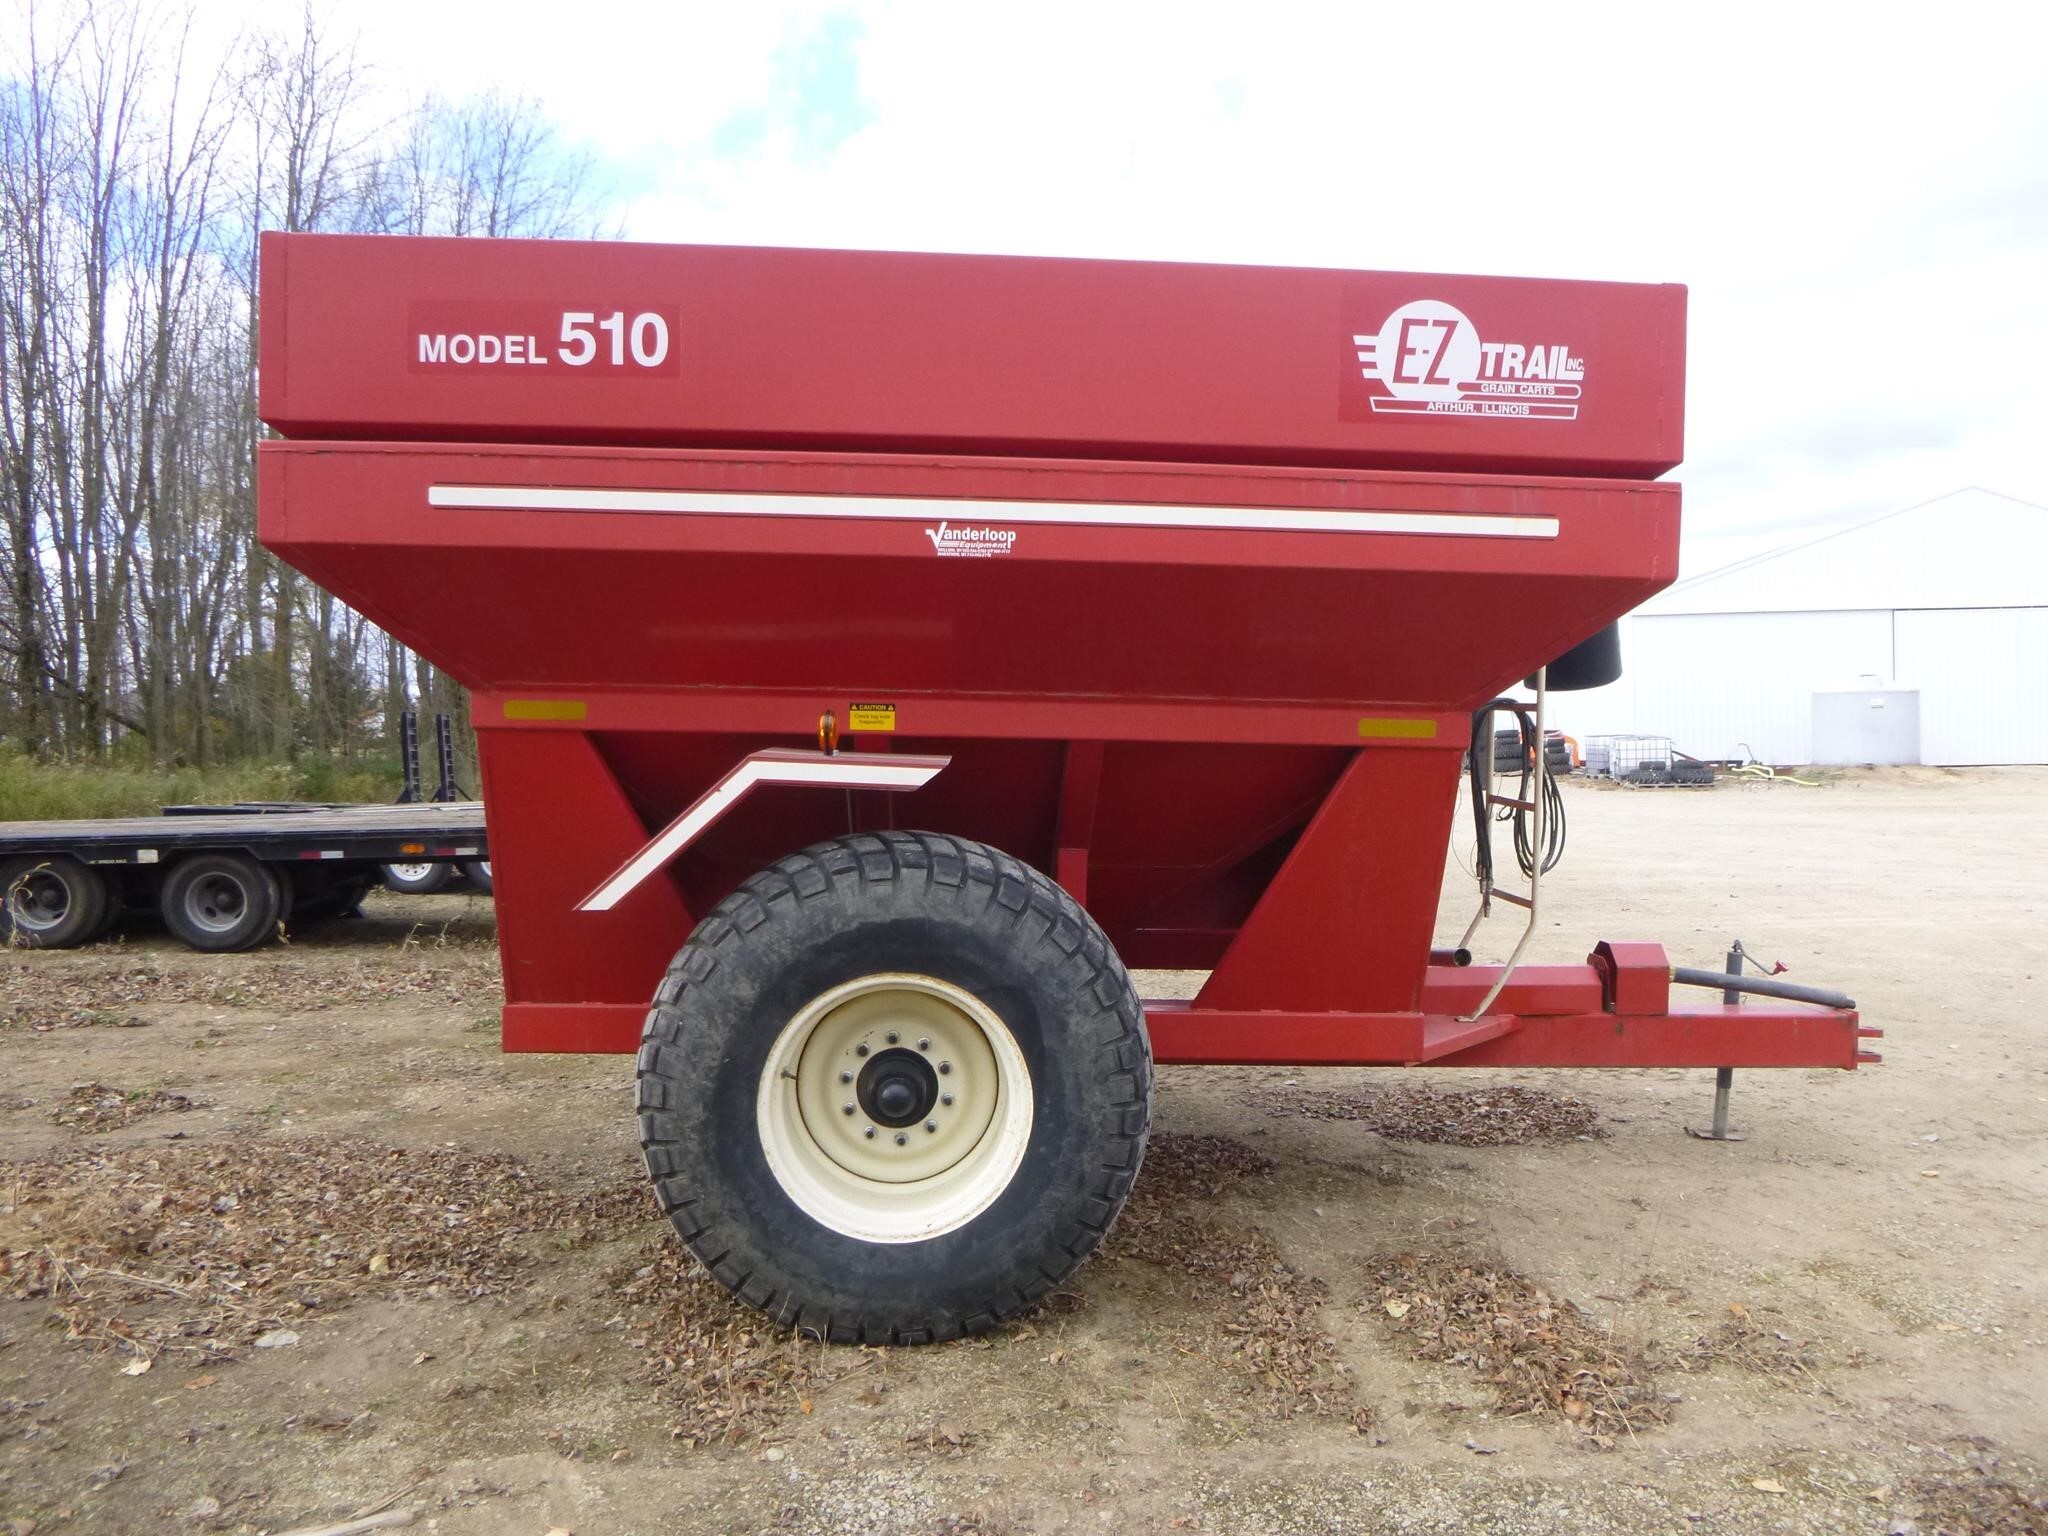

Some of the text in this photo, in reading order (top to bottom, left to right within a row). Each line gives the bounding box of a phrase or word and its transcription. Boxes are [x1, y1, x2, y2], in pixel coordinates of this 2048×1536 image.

[419, 311, 669, 367] MODEL 510
[1481, 342, 1585, 381] TRAIL
[1481, 383, 1556, 396] GRAIN CARTS
[1481, 403, 1530, 415] ILLINOIS
[925, 521, 1016, 549] Vanderloop
[959, 541, 1007, 549] Equipment
